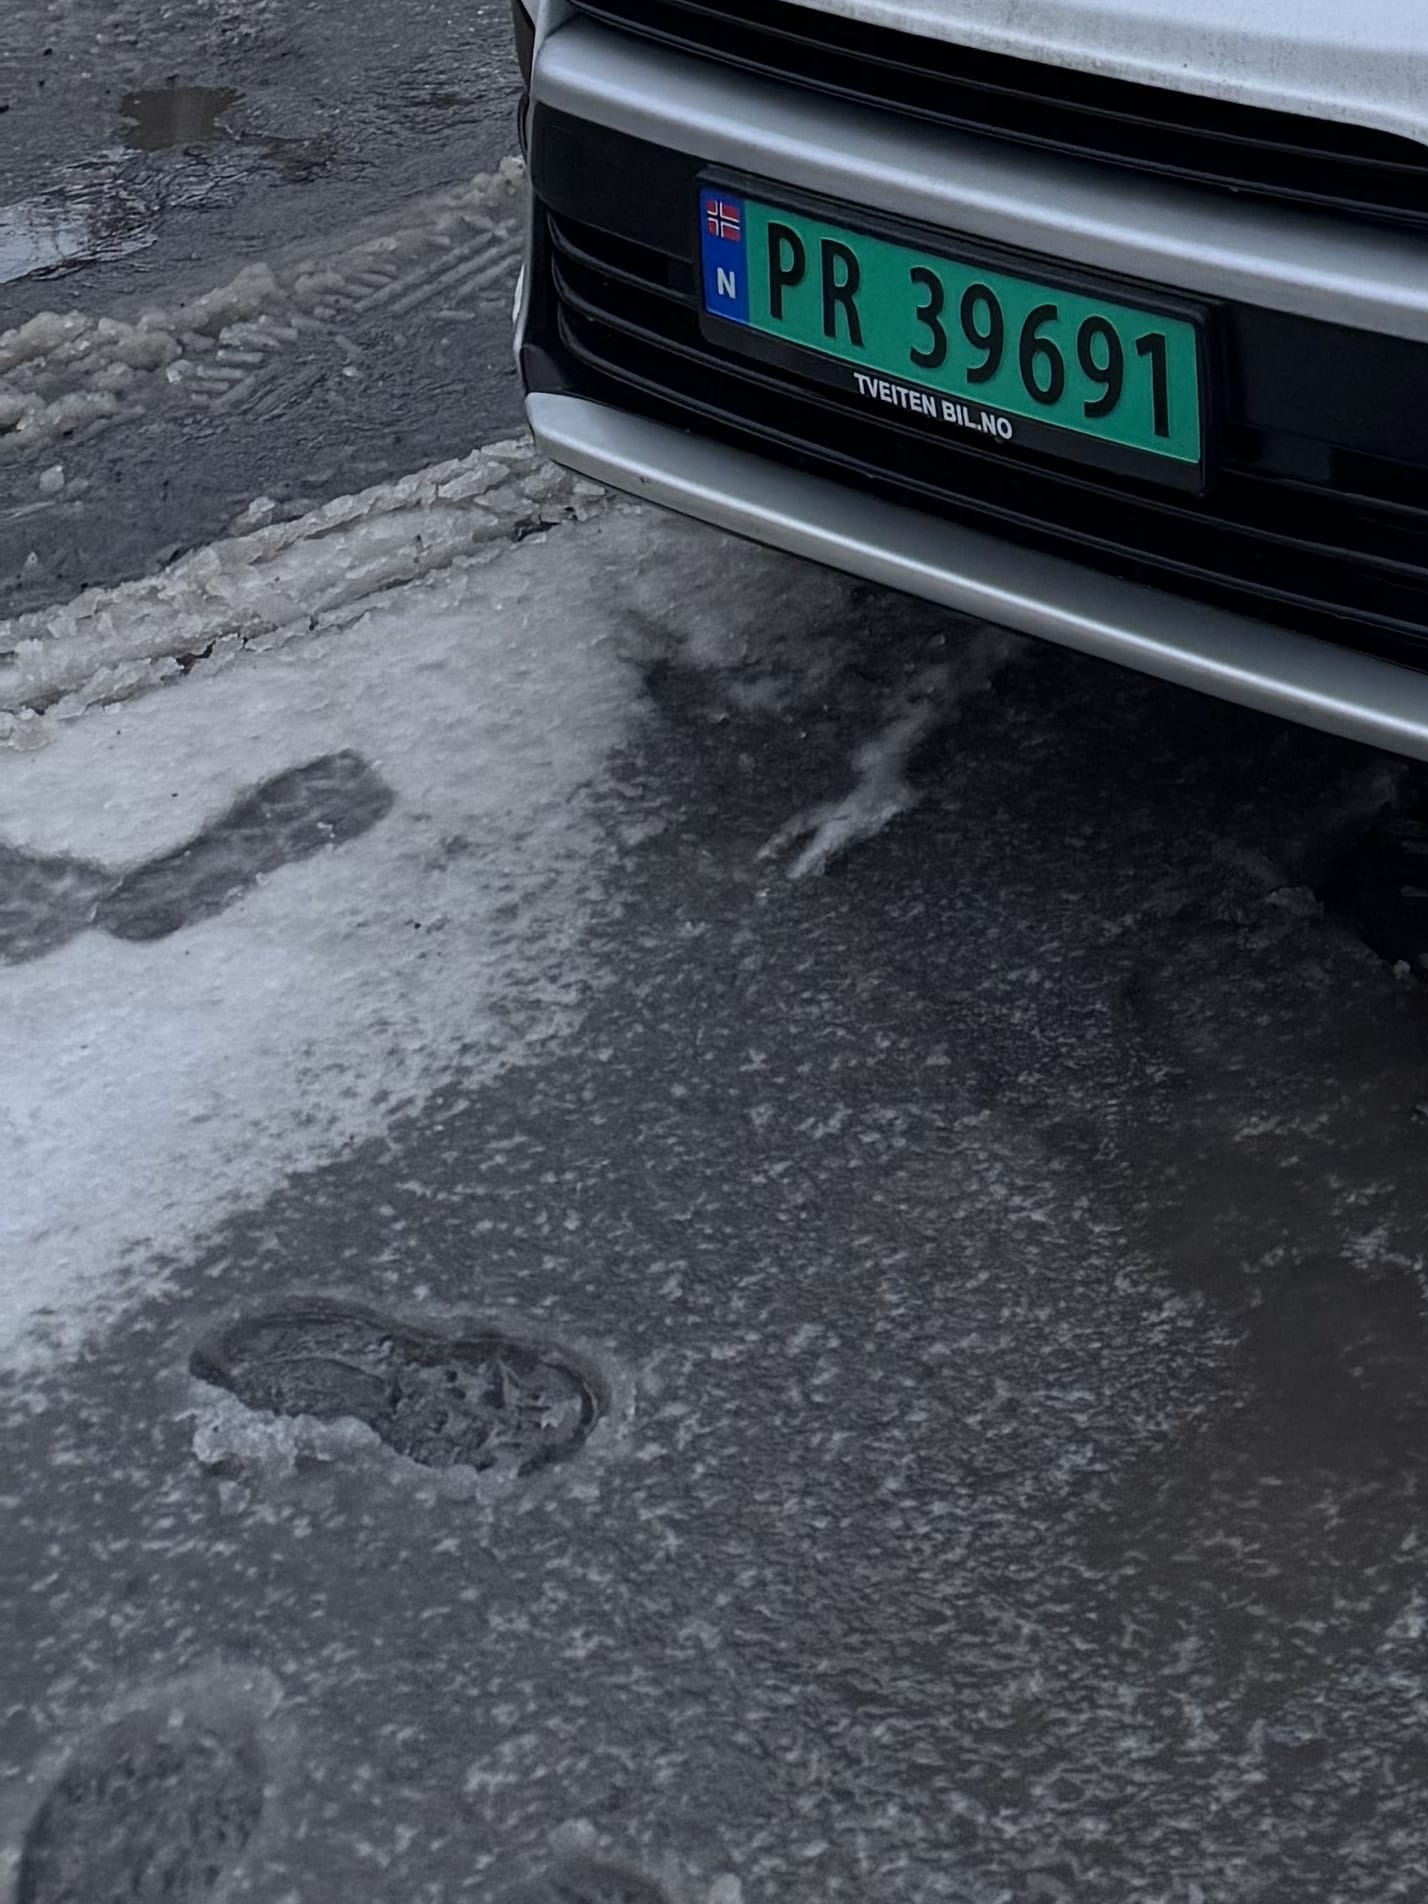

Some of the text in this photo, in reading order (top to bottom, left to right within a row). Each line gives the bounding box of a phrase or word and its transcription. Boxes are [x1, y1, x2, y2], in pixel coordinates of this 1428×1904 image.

[716, 267, 737, 299] N
[767, 222, 1170, 438] PR 39691
[853, 372, 1013, 440] TVEITEN BIL.NO
